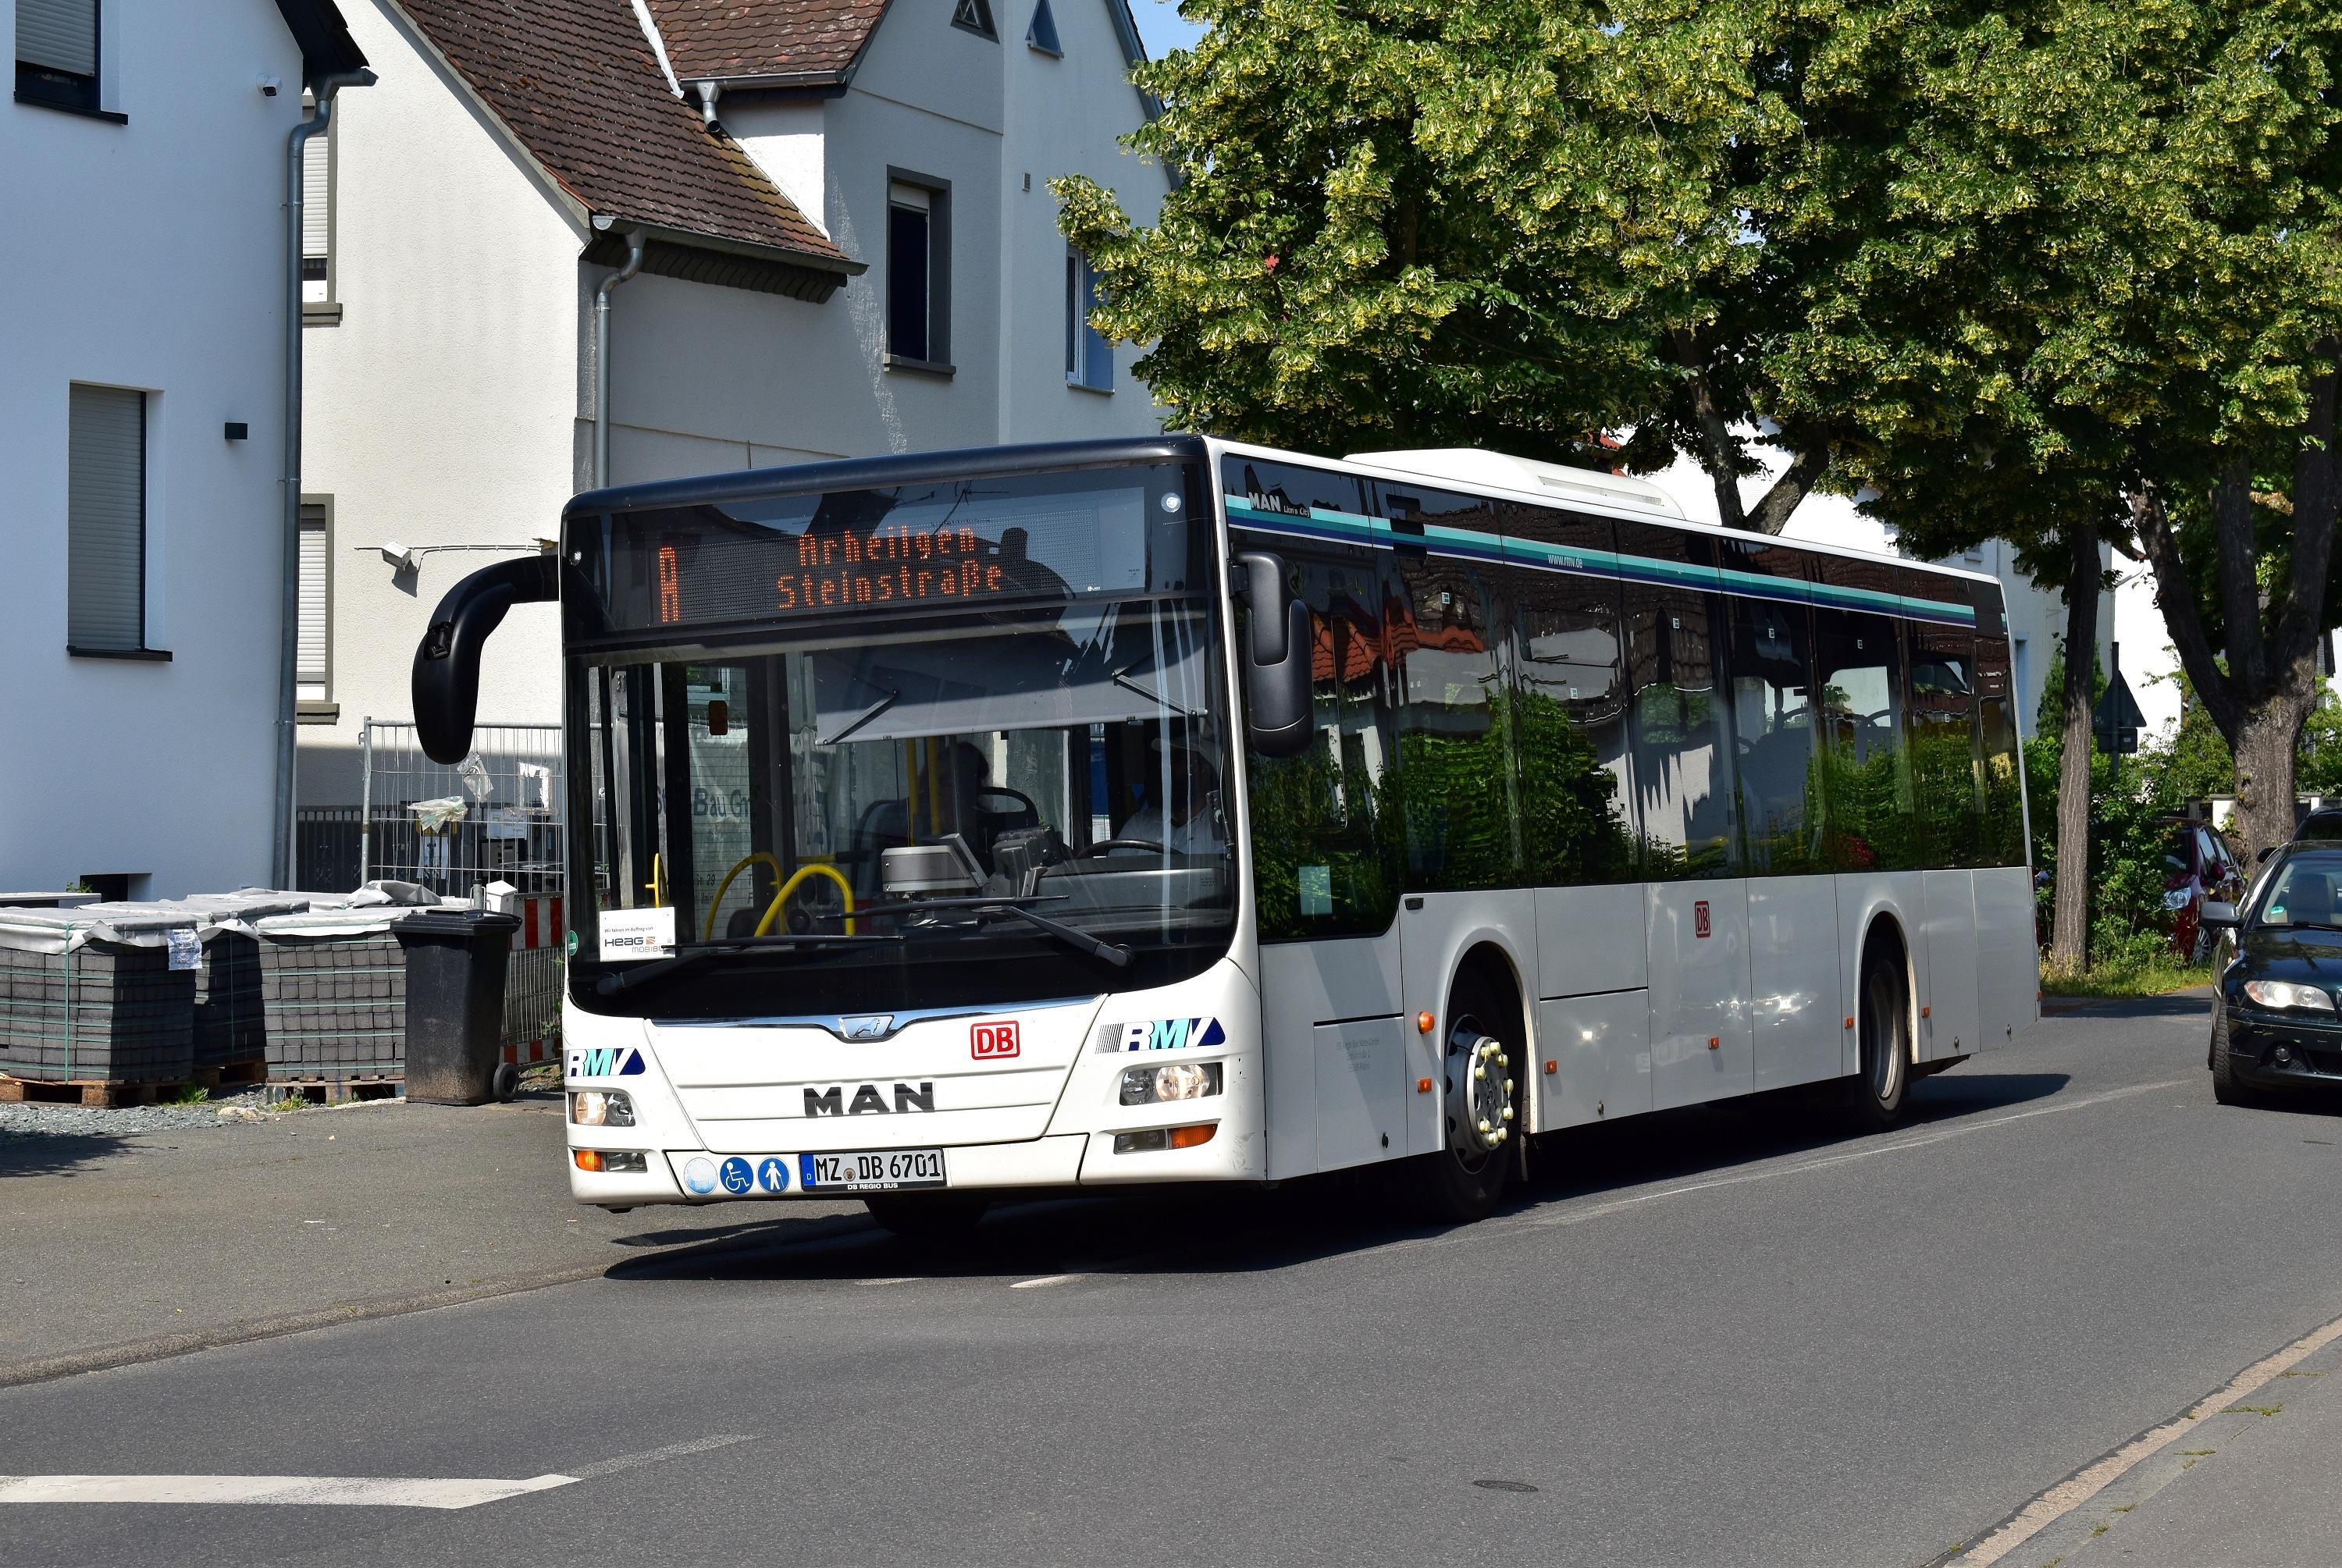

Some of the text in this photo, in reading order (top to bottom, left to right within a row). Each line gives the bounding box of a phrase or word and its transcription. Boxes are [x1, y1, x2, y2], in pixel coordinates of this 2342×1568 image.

[1248, 491, 1310, 517] MAN Lion's City
[799, 525, 976, 567] Arheilgen
[1547, 553, 1583, 569] www.rmv.de
[658, 547, 679, 623] A
[778, 559, 1002, 610] Steinstraße
[1696, 907, 1708, 932] DB
[977, 1026, 1014, 1054] DB
[1118, 1017, 1215, 1053] RMV
[566, 1047, 636, 1077] RMV
[803, 1082, 935, 1118] MAN
[815, 1157, 842, 1182] MZ
[857, 1155, 884, 1180] DB
[889, 1153, 941, 1179] 6701
